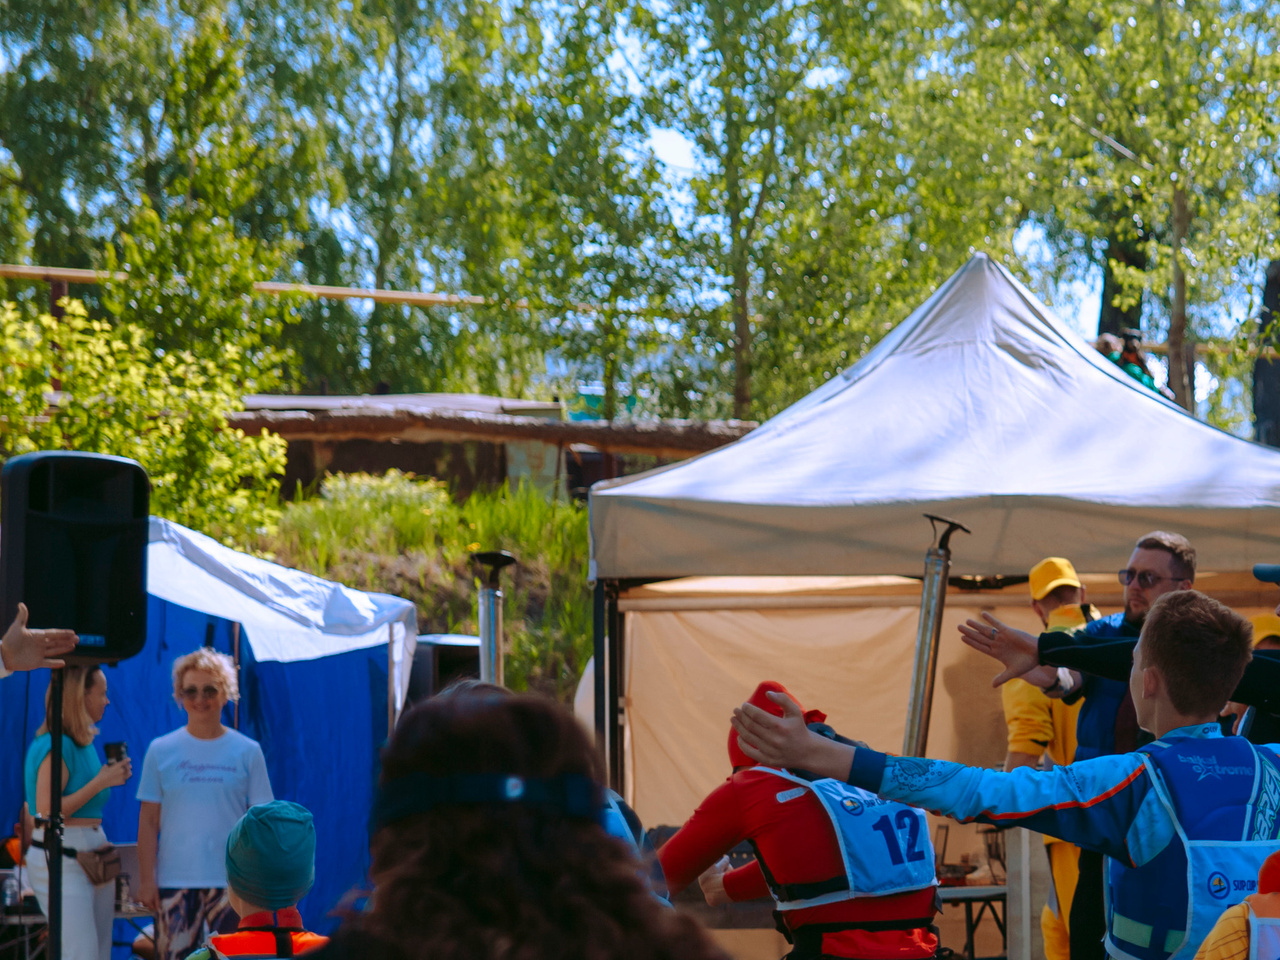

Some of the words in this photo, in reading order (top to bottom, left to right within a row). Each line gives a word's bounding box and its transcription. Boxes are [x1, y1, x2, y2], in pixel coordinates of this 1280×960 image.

[872, 809, 925, 866] 12
[1233, 880, 1245, 891] SUP
[1246, 880, 1256, 891] CUP
